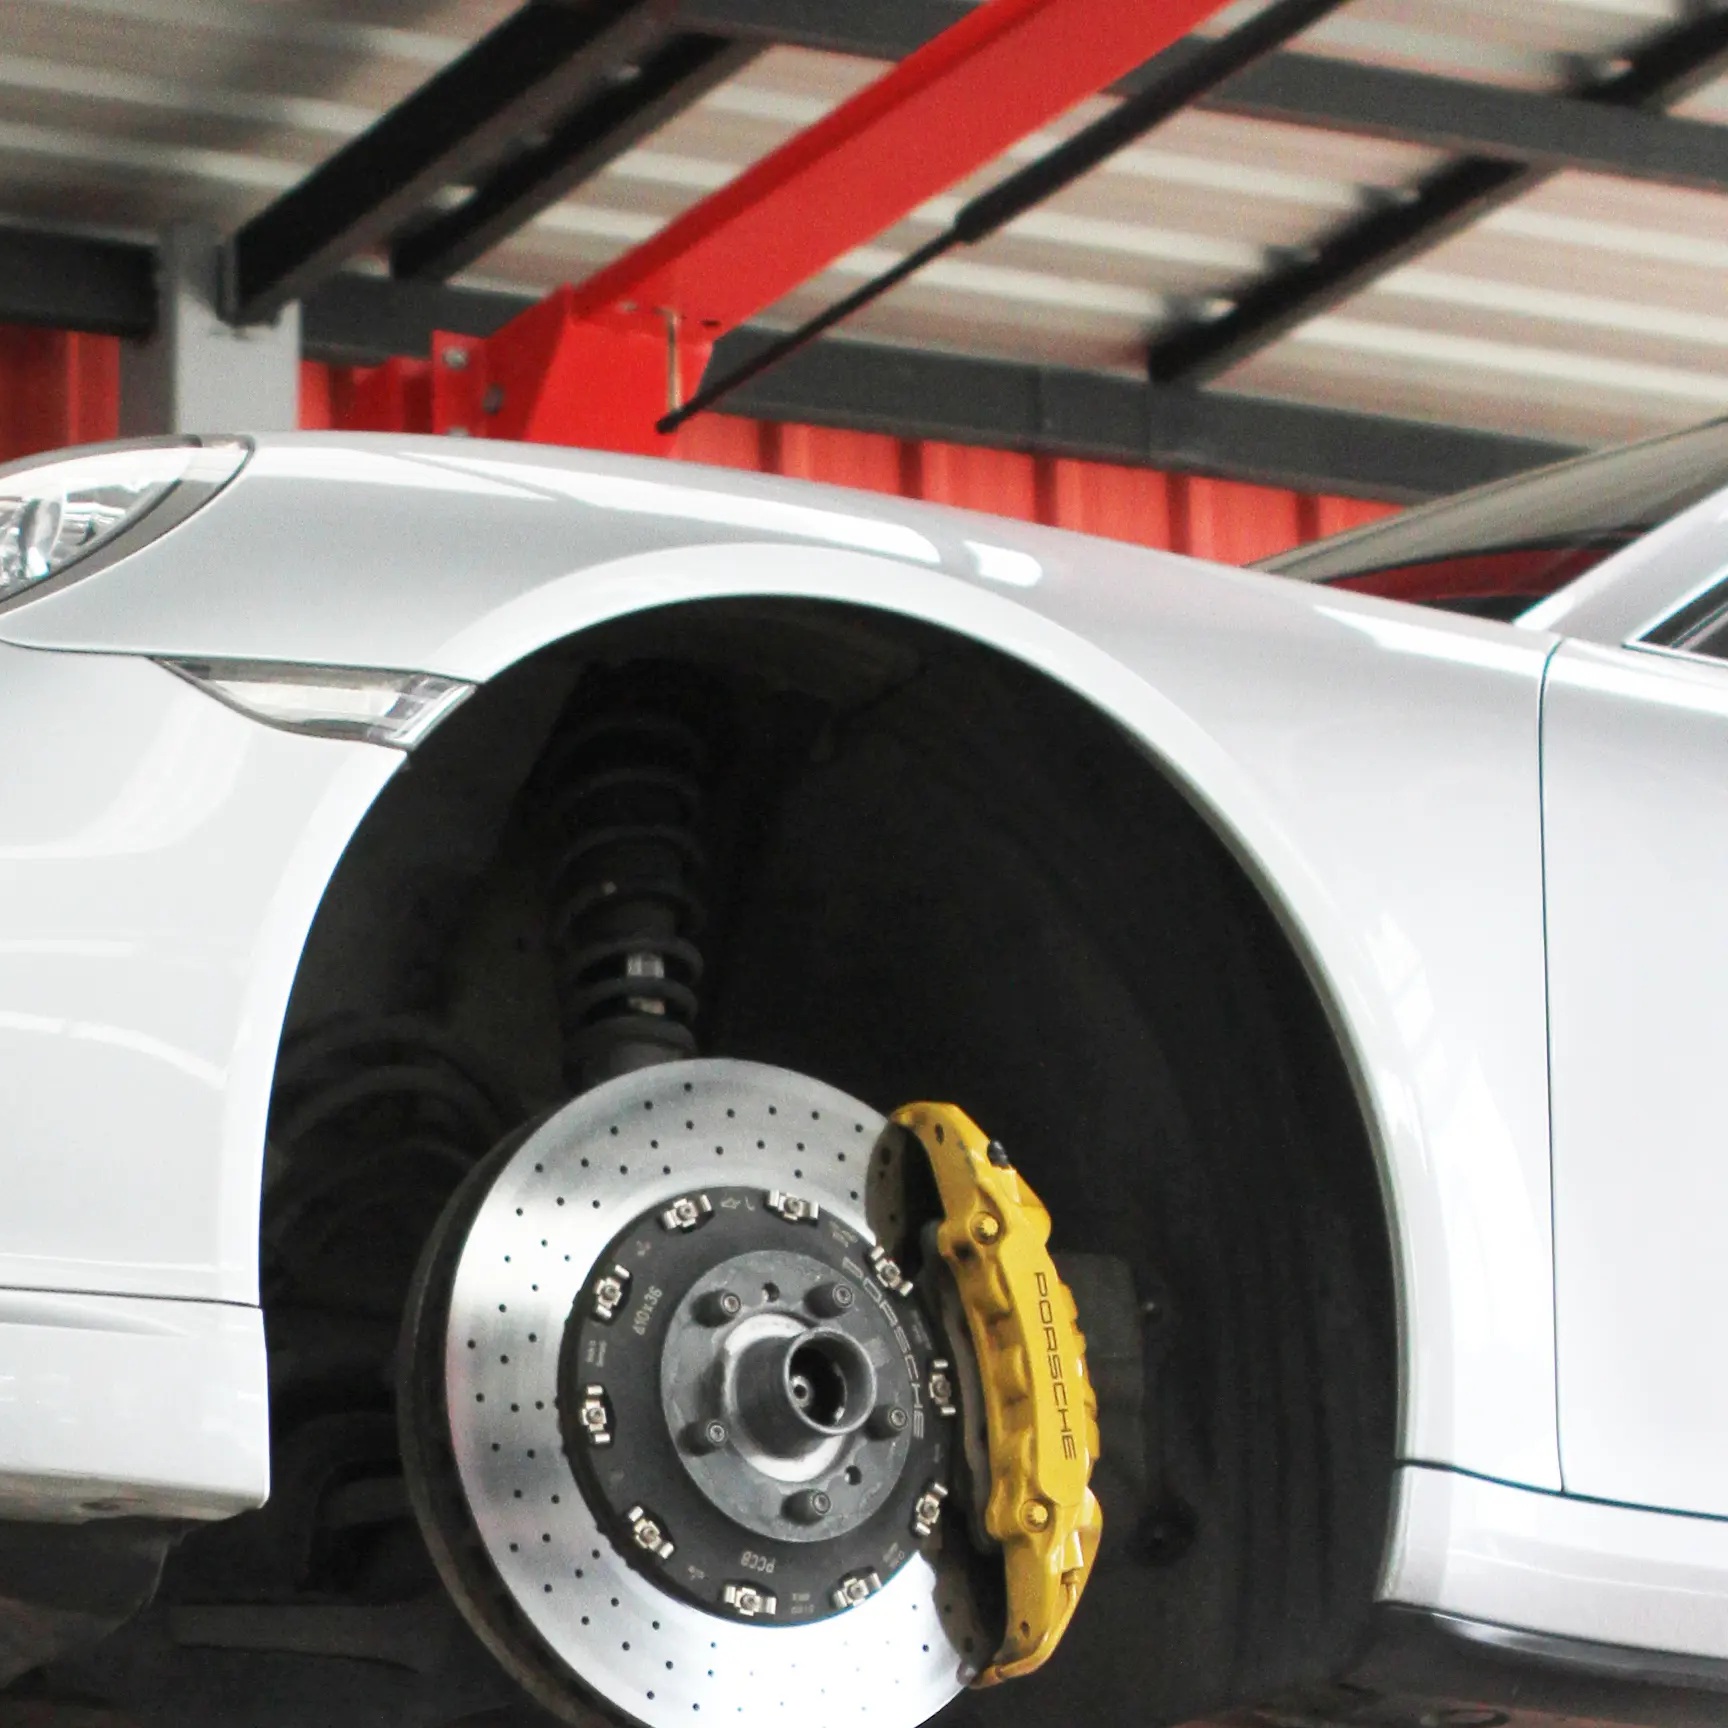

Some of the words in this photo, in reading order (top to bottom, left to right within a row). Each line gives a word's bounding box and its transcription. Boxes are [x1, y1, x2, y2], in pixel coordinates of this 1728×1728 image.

[842, 1256, 924, 1439] PORSCHE
[1034, 1272, 1077, 1461] PORSCHE
[740, 1550, 776, 1573] PCCB
